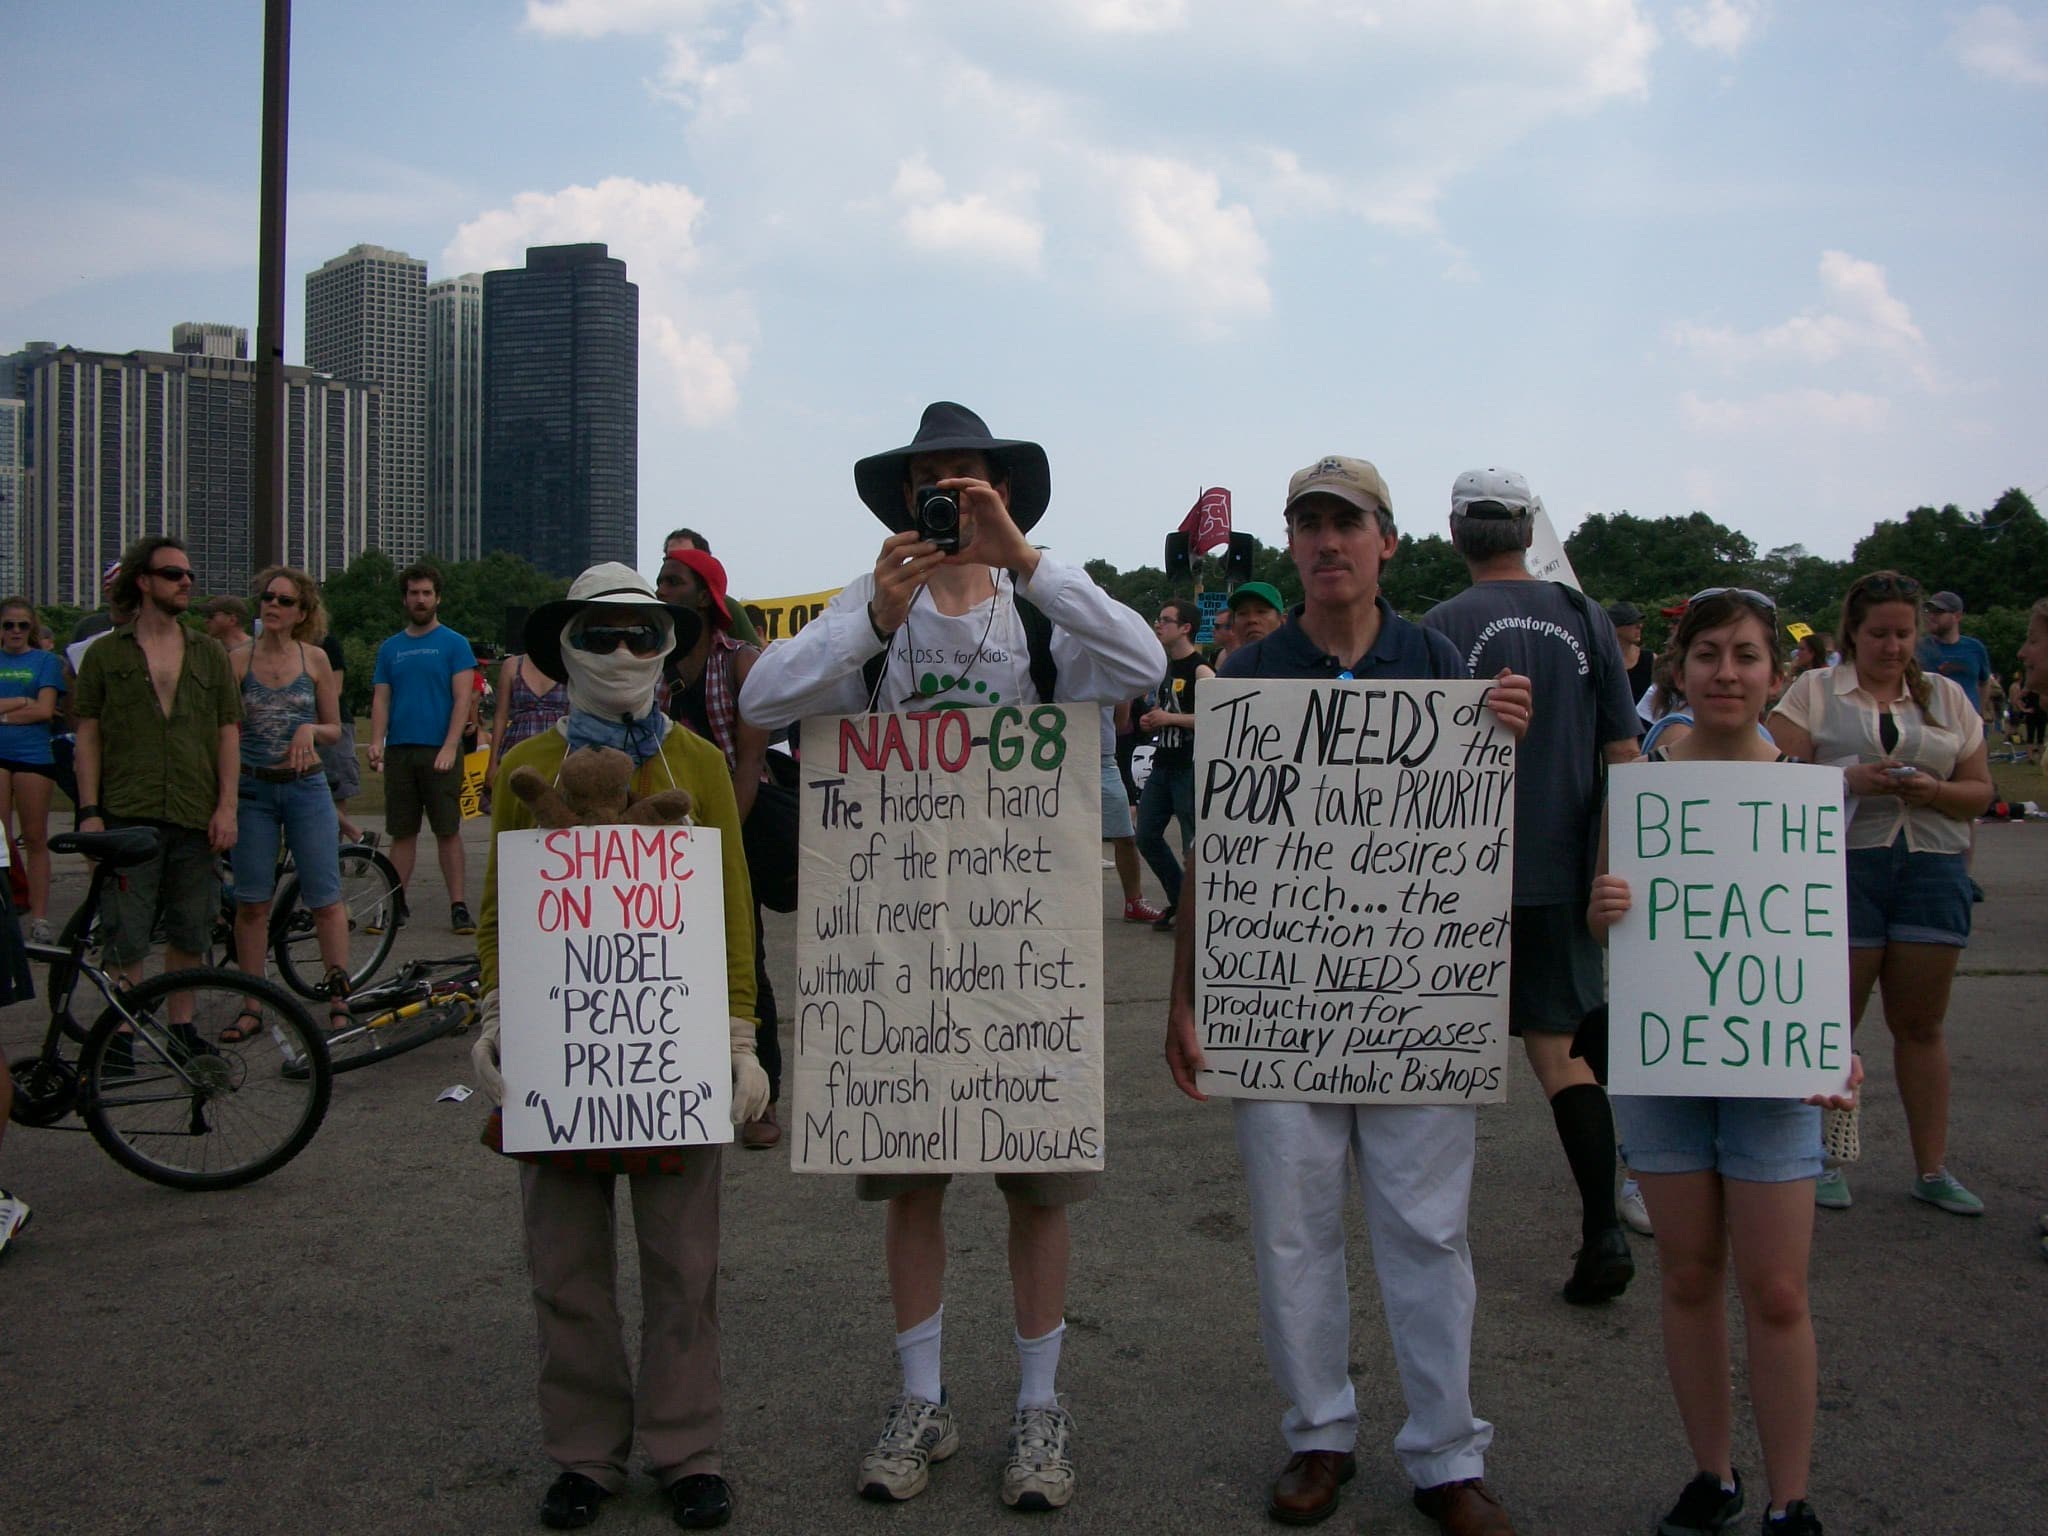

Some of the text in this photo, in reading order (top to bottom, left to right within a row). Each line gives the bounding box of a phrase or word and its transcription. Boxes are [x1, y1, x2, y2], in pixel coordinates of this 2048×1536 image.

[954, 651, 974, 664] for
[979, 648, 1008, 664] Kids
[838, 705, 1067, 773] NATO-G8
[1210, 687, 1495, 768] The NEEDS of
[1461, 726, 1513, 767] the
[808, 766, 1062, 829] The hidden hand
[1200, 758, 1514, 830] POOR take PRIORITY
[1637, 792, 1838, 858] BE THE
[539, 828, 694, 881] SHAME
[850, 828, 1052, 882] of the market
[1202, 828, 1510, 876] over the desires of
[538, 883, 684, 935] ON YOU,
[817, 886, 1043, 940] will never work
[1201, 870, 1258, 905] the
[1397, 879, 1460, 915] the
[1649, 877, 1833, 941] PEACE
[1385, 917, 1425, 949] to
[1434, 911, 1511, 949] meet
[565, 932, 682, 984] NOBEL
[799, 940, 1086, 996] without a hidden fist.
[1202, 946, 1507, 991] SOCIAL NEEDS over
[1694, 951, 1803, 1006] YOU
[549, 983, 688, 1034] "PEACE"
[801, 997, 1084, 1055] McDonald's cannot
[1203, 990, 1424, 1025] production for
[564, 1039, 682, 1088] PRIZE
[1207, 1018, 1498, 1060] military purposes.
[1641, 1011, 1841, 1070] DESIRE
[825, 1059, 1059, 1107] flourish without
[1293, 1060, 1393, 1095] Catholic
[1400, 1057, 1501, 1099] Bishops
[525, 1081, 712, 1143] "WINNER"
